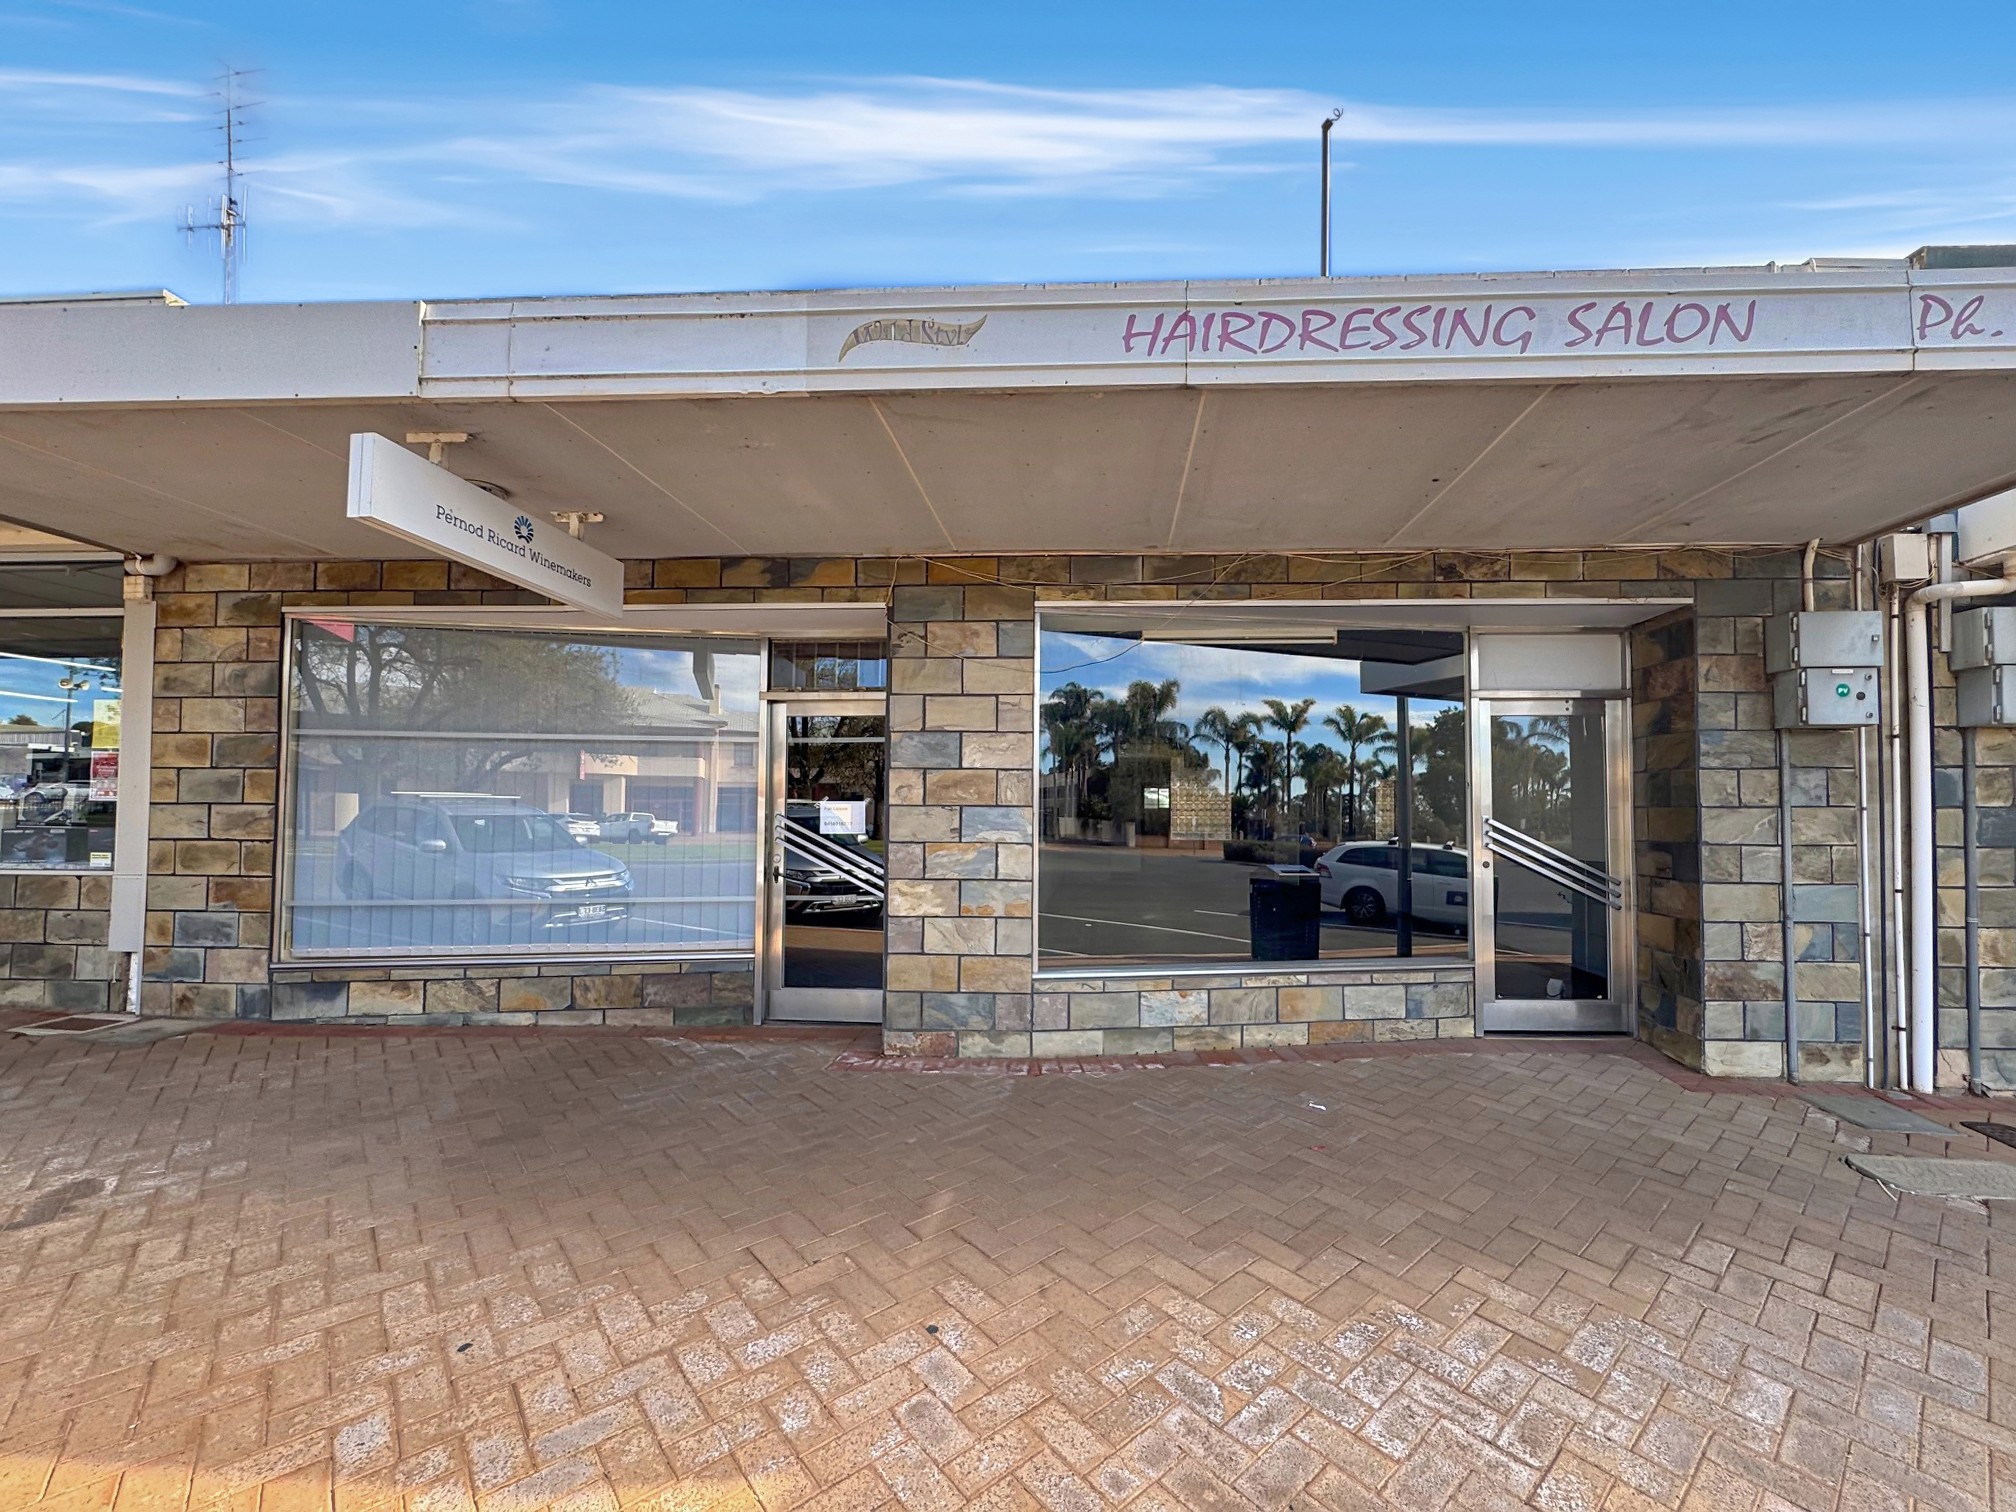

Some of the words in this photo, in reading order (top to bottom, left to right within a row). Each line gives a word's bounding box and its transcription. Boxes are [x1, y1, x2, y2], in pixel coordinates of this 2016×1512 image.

[1122, 304, 1536, 356] HAIRDRESSING
[1564, 299, 1757, 348] SALON
[1916, 294, 2004, 341] Ph.
[435, 504, 484, 539] Pernod
[487, 528, 526, 557] Ricard
[529, 548, 592, 588] Winemakers
